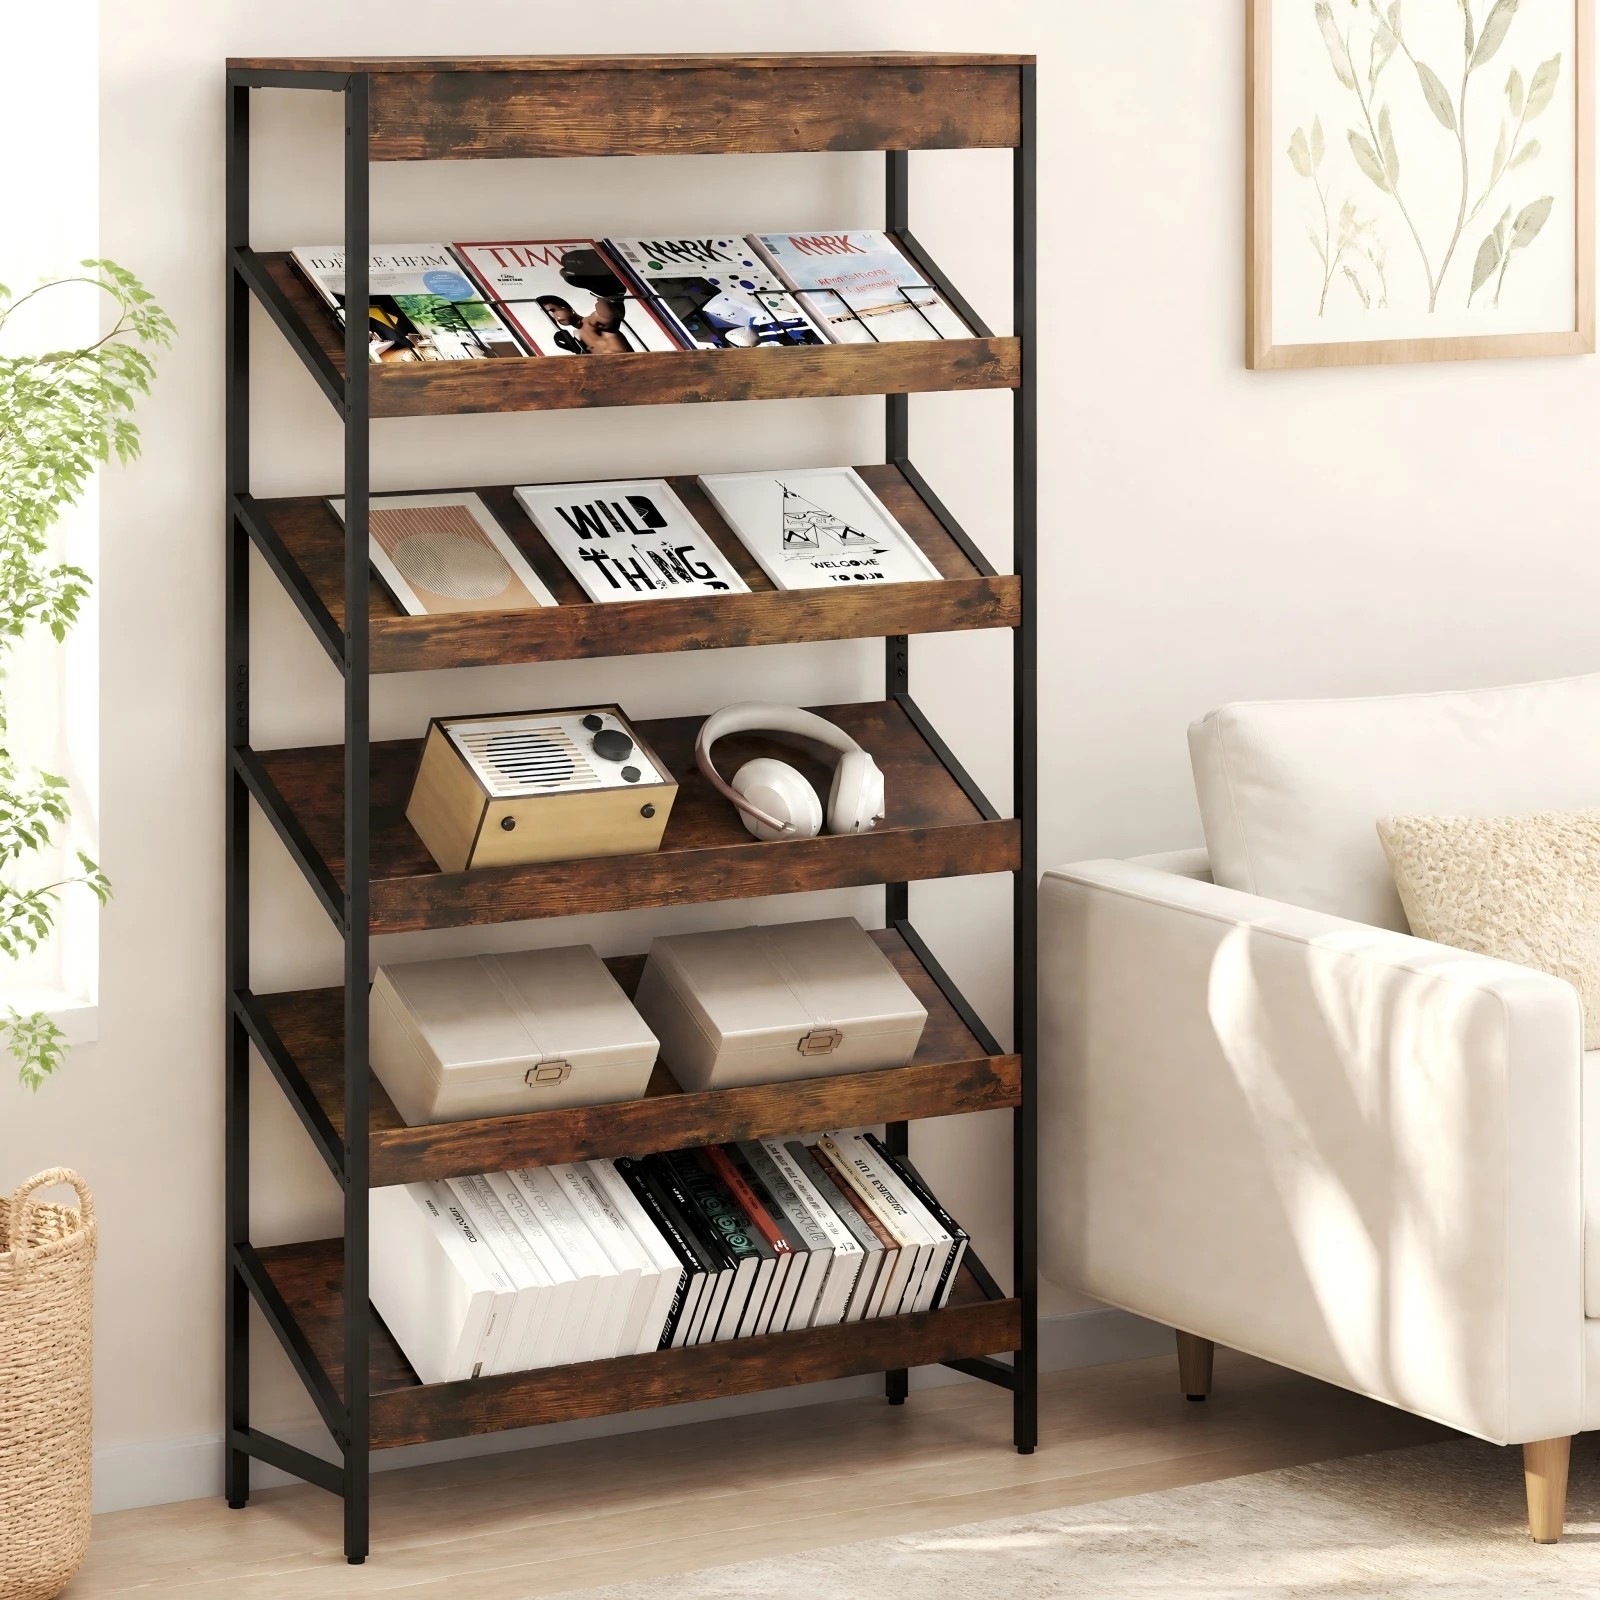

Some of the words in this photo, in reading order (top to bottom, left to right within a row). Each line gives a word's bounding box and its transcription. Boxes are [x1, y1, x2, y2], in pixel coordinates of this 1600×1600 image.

[637, 239, 734, 264] MARK
[787, 234, 867, 256] MARK
[554, 495, 668, 540] WILD
[577, 540, 718, 592] THING
[810, 558, 881, 569] WELCOME
[828, 574, 851, 582] TO
